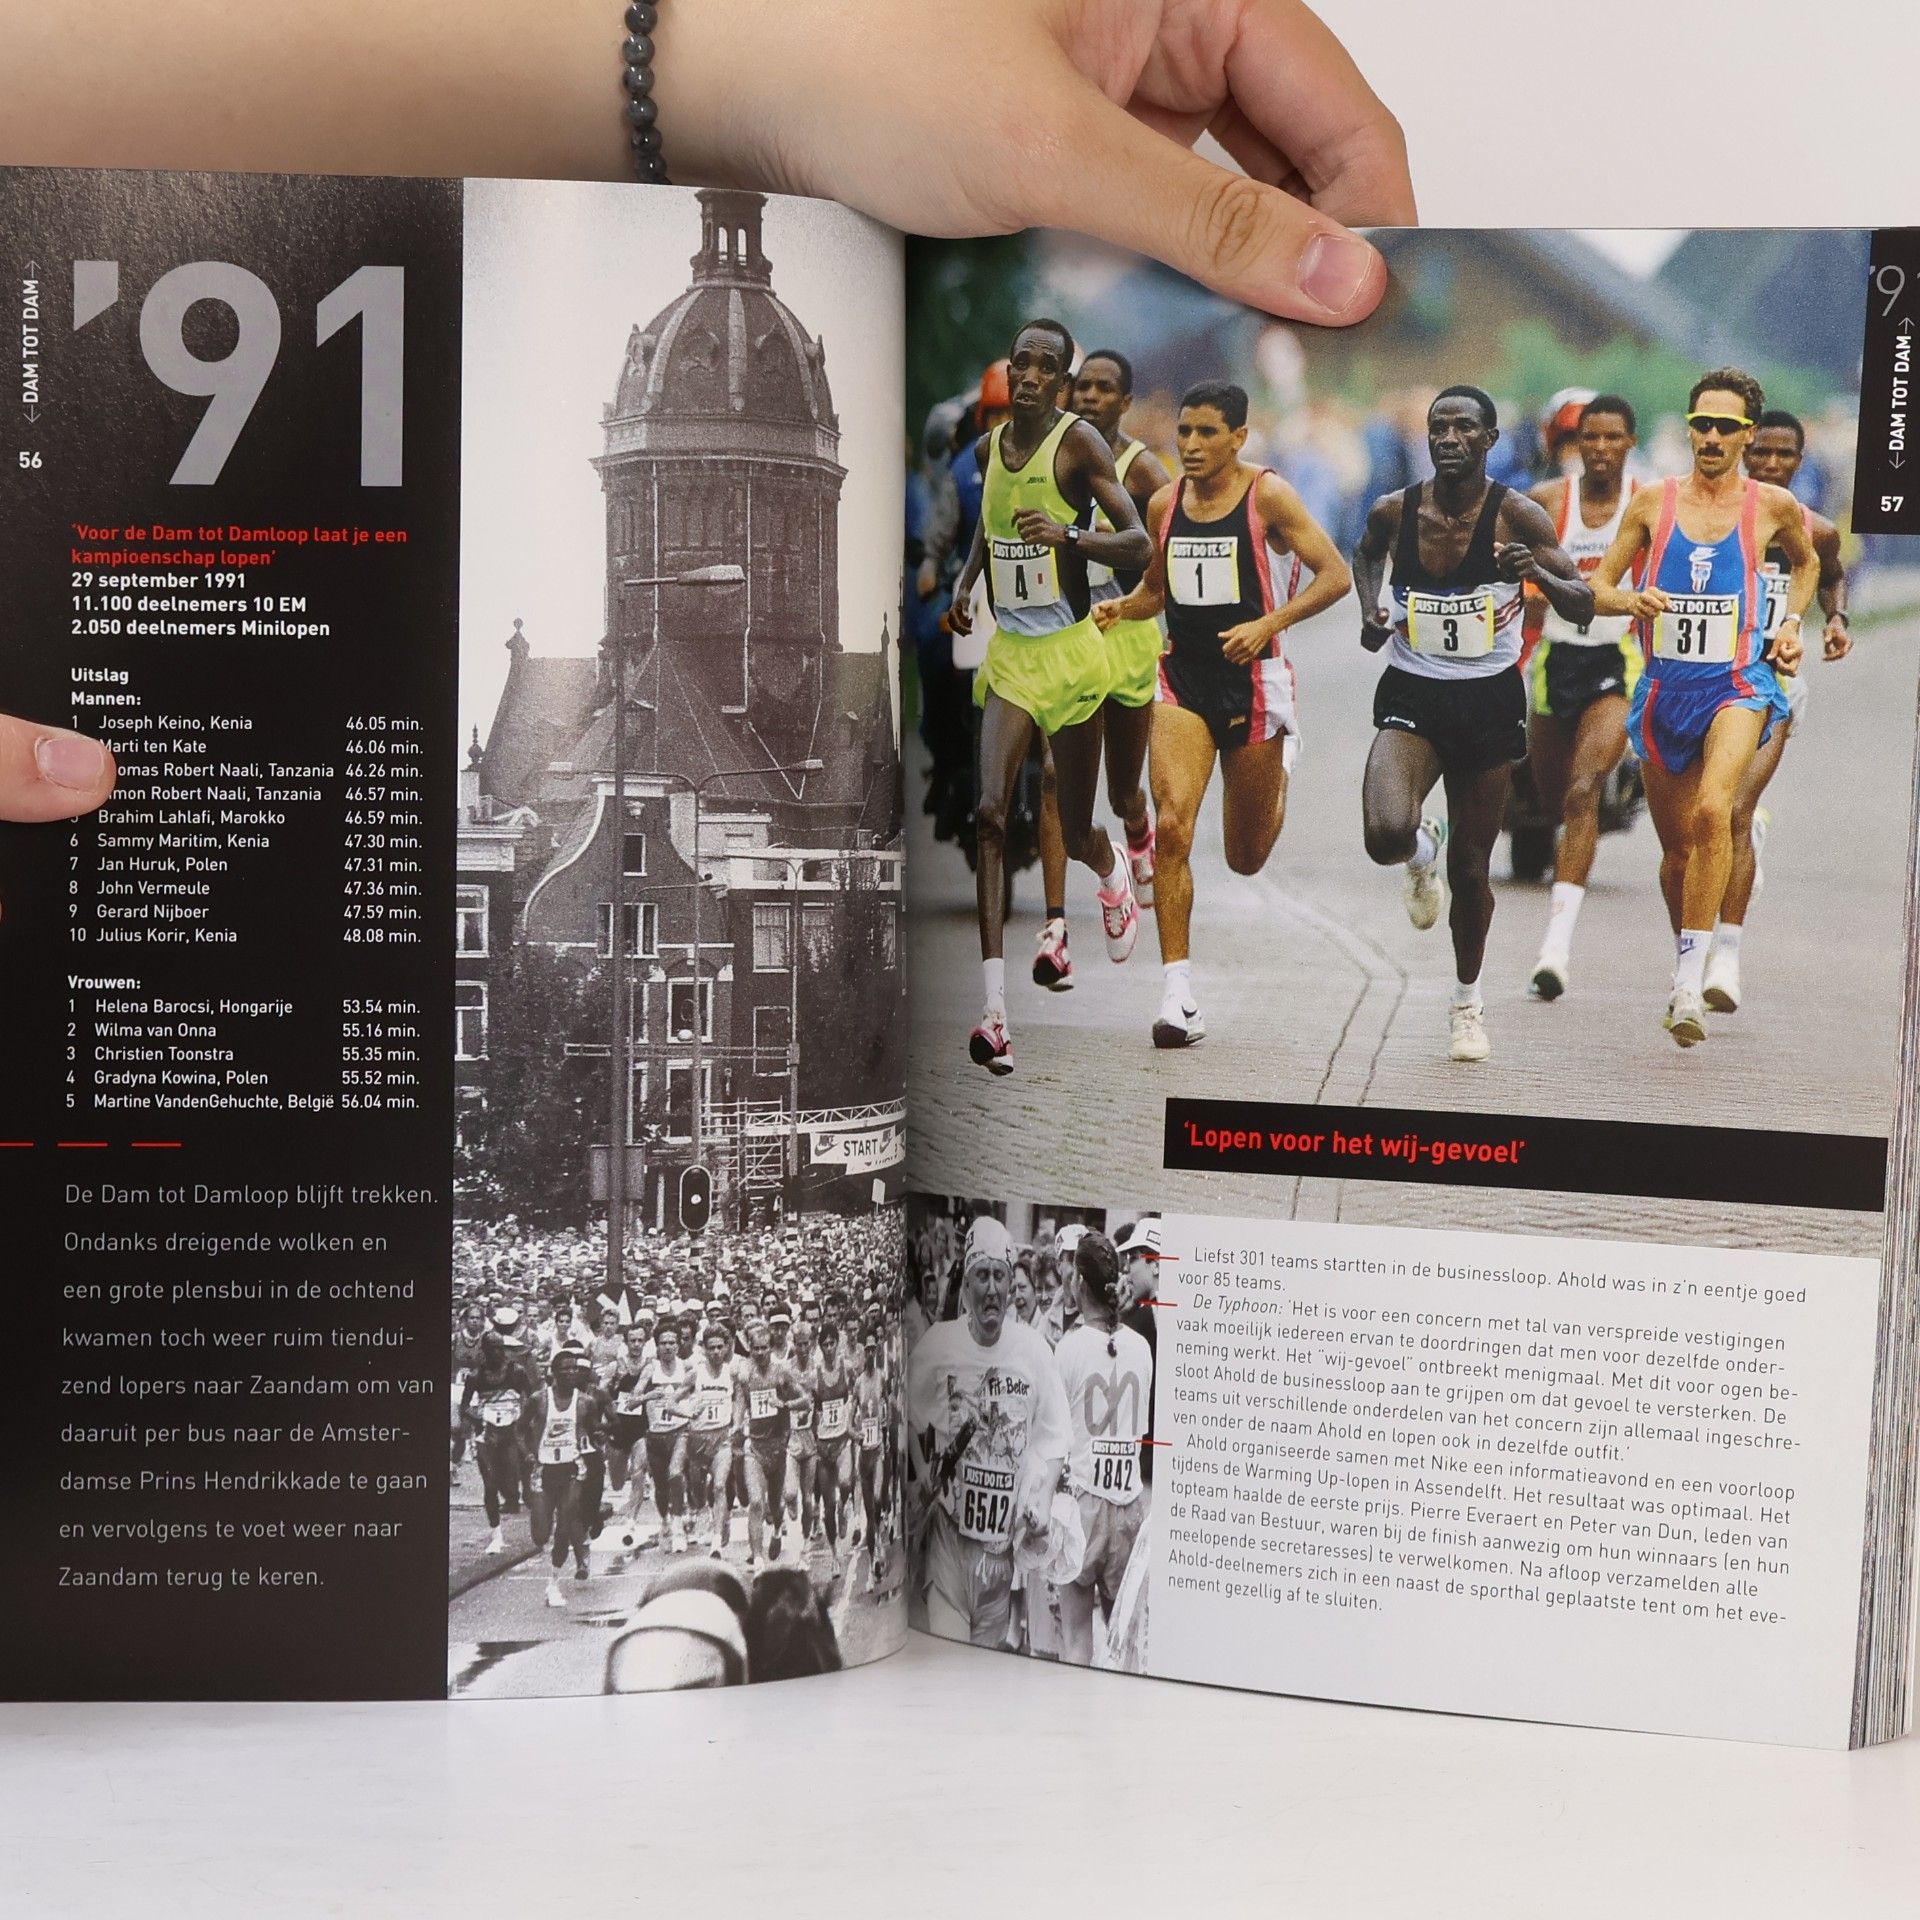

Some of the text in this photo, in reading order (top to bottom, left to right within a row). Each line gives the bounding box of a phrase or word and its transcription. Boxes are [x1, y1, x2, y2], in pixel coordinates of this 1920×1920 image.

[1869, 265, 1920, 317] '9
[22, 278, 39, 404] DAM TOT DAM
[73, 260, 405, 487] '91
[1889, 335, 1912, 451] DAM TOT DAM
[18, 451, 43, 469] 56
[1880, 495, 1904, 512] 57
[124, 526, 146, 540] de
[153, 526, 192, 540] Dam
[198, 527, 223, 540] tot
[229, 526, 309, 544] Damloop
[314, 527, 348, 542] laat
[352, 528, 370, 545] je
[375, 531, 408, 542] een
[72, 549, 214, 568] kampioenschap
[1010, 545, 1024, 558] DO
[72, 572, 244, 591] 29 september 1991
[1016, 565, 1028, 600] 4
[1195, 563, 1203, 598] 1
[73, 596, 306, 612] 11.100 deelnemers 10 EM
[1415, 599, 1474, 614] JUST DO IT.
[1672, 600, 1720, 614] ST DO IT.
[72, 619, 330, 639] 2.050 deelnemers Minilopen
[1443, 619, 1458, 651] 3
[1677, 618, 1707, 655] 31
[72, 668, 128, 685] Uitslag
[72, 692, 140, 705] Mannen:
[72, 715, 423, 732] 1 Joseph Keino, Kenia 46.05 min.
[100, 739, 423, 754] Marti ten Kate 46.06 min.
[118, 763, 423, 778] omas Robert Naali, Tanzania 46.26 min.
[70, 928, 421, 944] 10 Julius Korir, Kenia 48.08 min.
[68, 975, 140, 989] Vrouwen:
[69, 999, 420, 1017] 1 Helena Barocsi, Hongarije 53.54 min.
[66, 1094, 419, 1112] 5 Martine VandenGehuchte, België 56.04 min.
[843, 1139, 878, 1156] START
[1270, 1134, 1325, 1152] voor
[1333, 1131, 1372, 1155] het
[66, 1184, 438, 1208] De Dam tot Damloop blijft trekken.
[1178, 1272, 1285, 1290] voor 85 teams.
[64, 1327, 413, 1346] kwamen toch weer ruim tiendui-
[1177, 1342, 1228, 1361] neming
[1234, 1346, 1279, 1361] werkt.
[1287, 1348, 1312, 1364] Het
[1419, 1360, 1498, 1378] ontbreekt
[1505, 1366, 1604, 1386] menigmaal.
[1612, 1372, 1643, 1389] Met
[1650, 1375, 1670, 1391] dit
[1677, 1381, 1714, 1394] voor
[1721, 1384, 1762, 1400] ogen
[1770, 1384, 1798, 1400] be-
[707, 1406, 719, 1420] 51
[966, 1467, 983, 1485] JUST
[984, 1472, 995, 1487] DO
[1094, 1457, 1133, 1492] 1842
[1187, 1434, 1794, 1504] Ahold organiseerde samen met Nike een informatieavond en een voorloop
[60, 1470, 426, 1494] damse Prins Hendrikkade te gaan
[964, 1489, 1009, 1534] 6542
[1169, 1576, 1382, 1610] nement gezellig af te sluiten.
